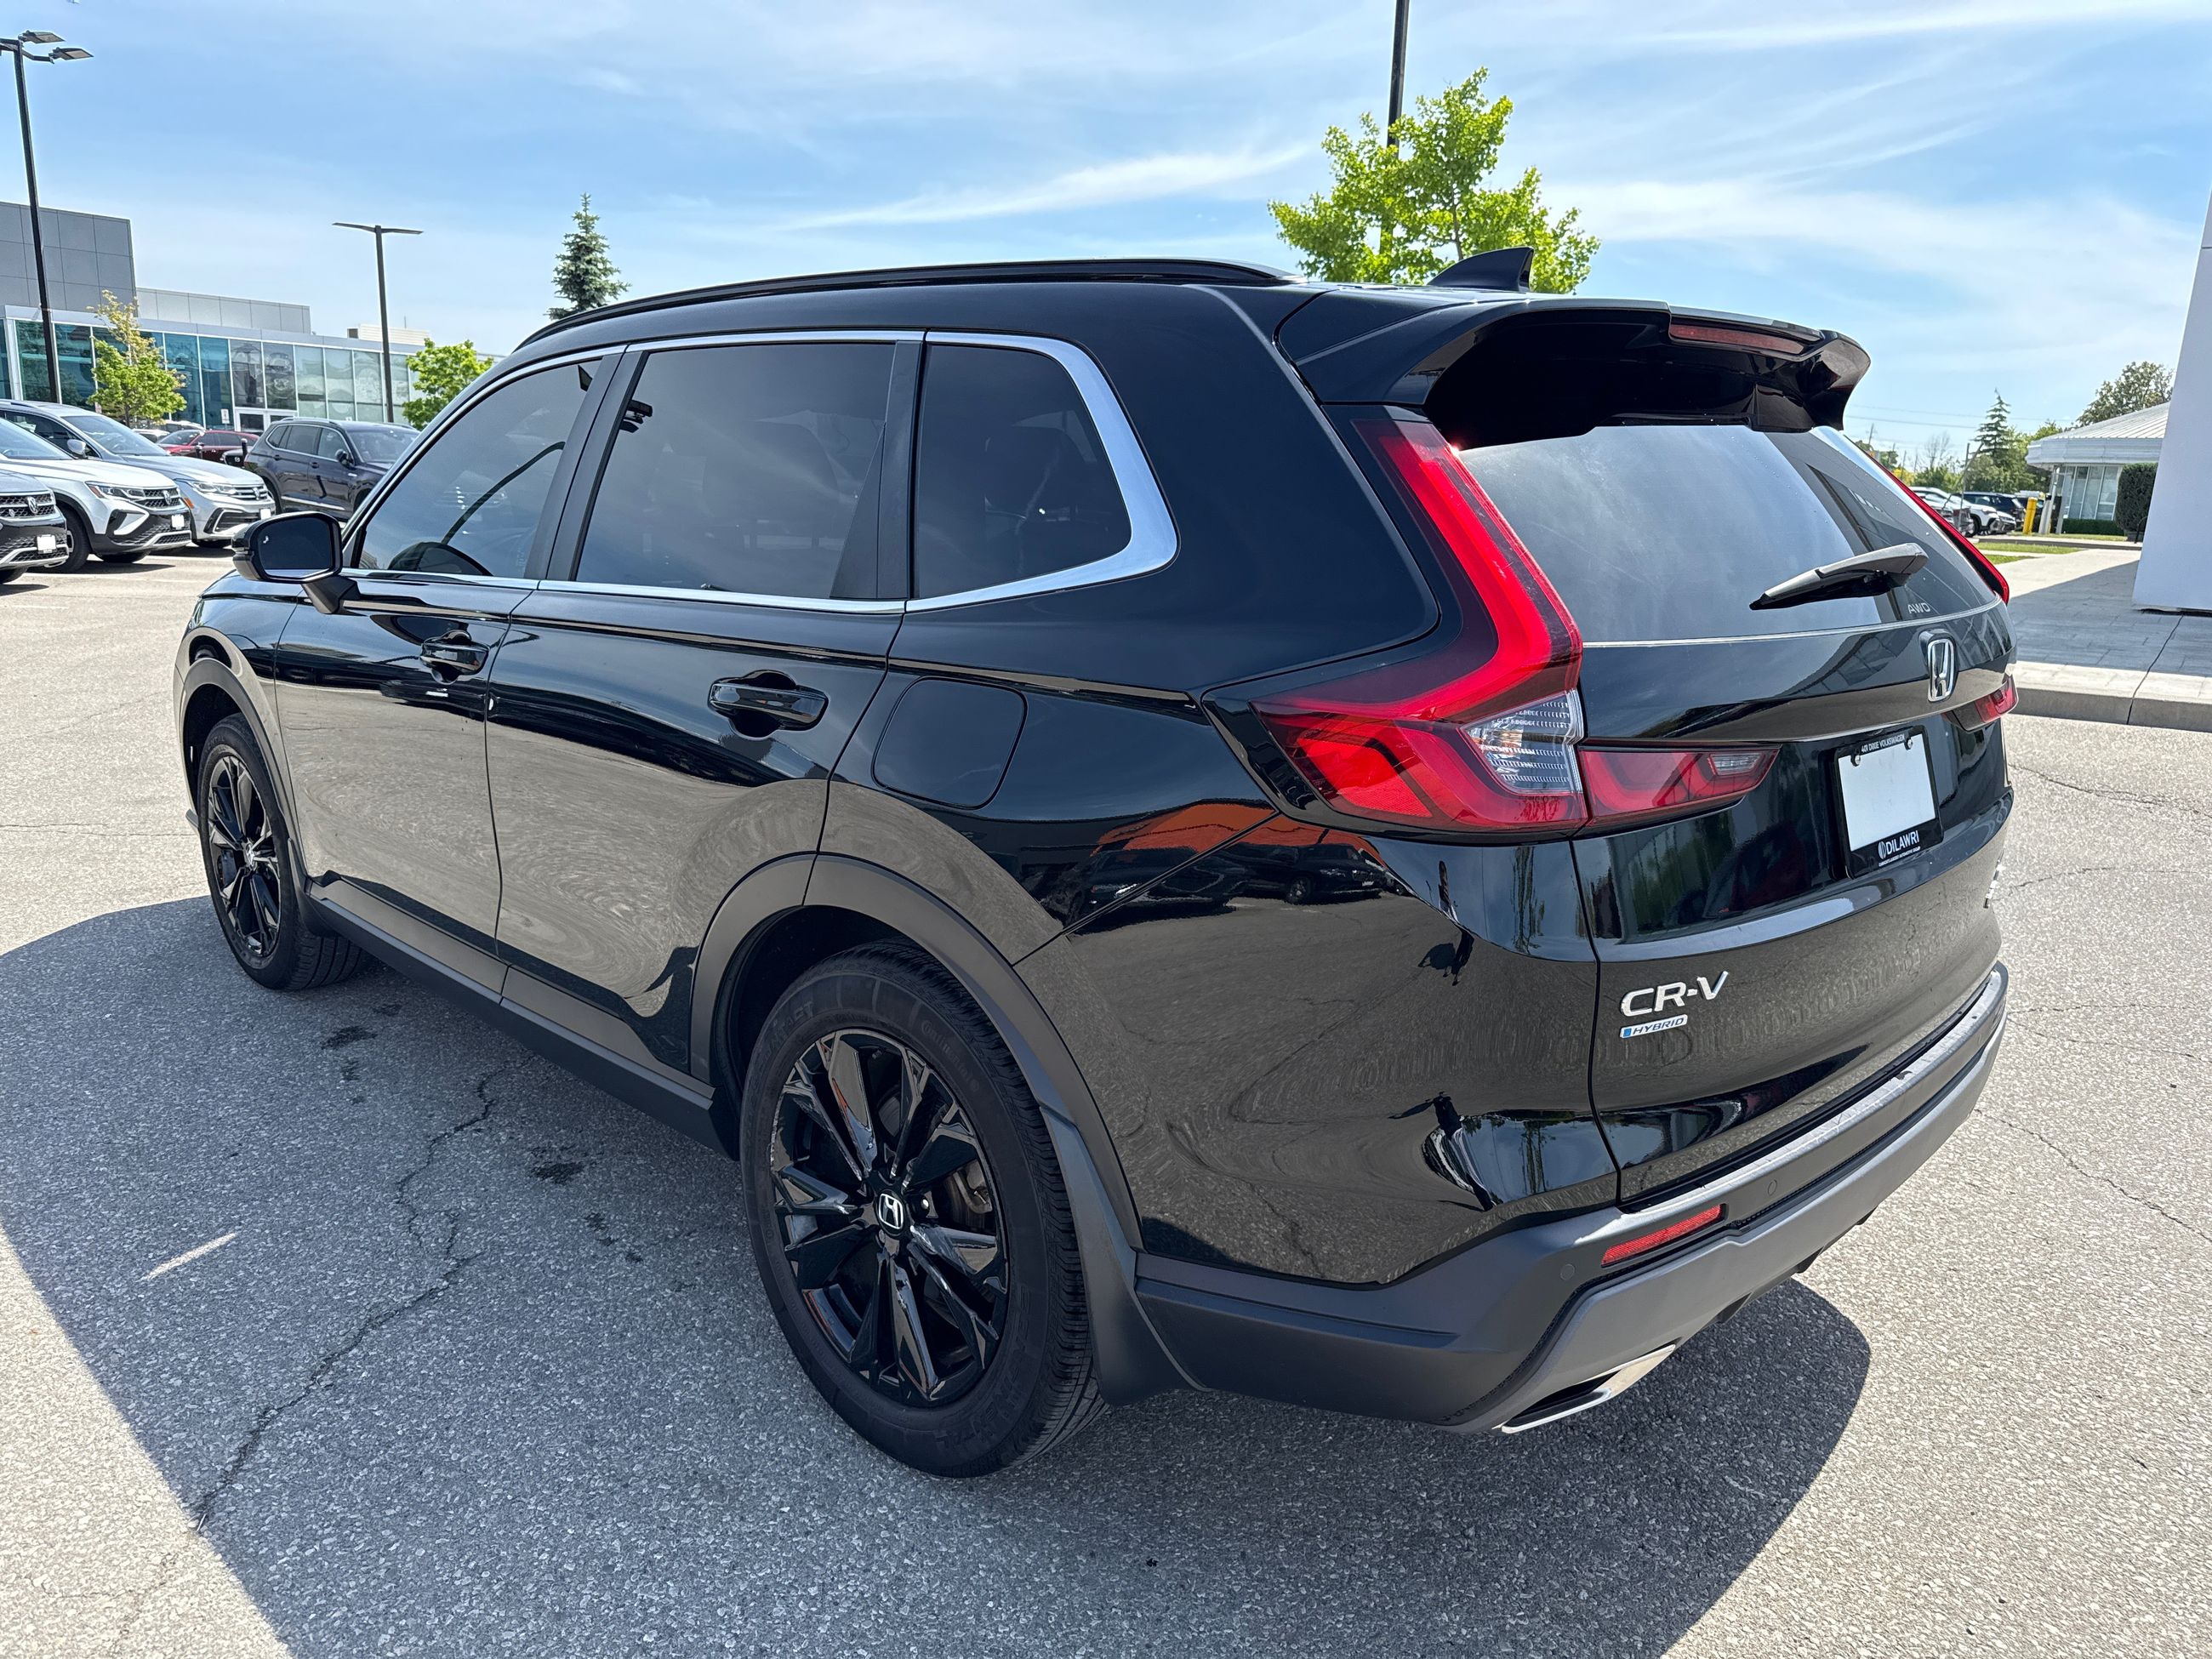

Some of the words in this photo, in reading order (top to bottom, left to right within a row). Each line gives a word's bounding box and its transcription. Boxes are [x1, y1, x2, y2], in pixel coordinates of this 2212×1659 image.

[1907, 602, 1931, 614] AWD
[1879, 733, 1905, 748] VOLKSWAGEN
[1885, 830, 1920, 855] DILAWRI
[1620, 971, 1729, 1017] CR-V
[1632, 1017, 1685, 1035] HYBRID
